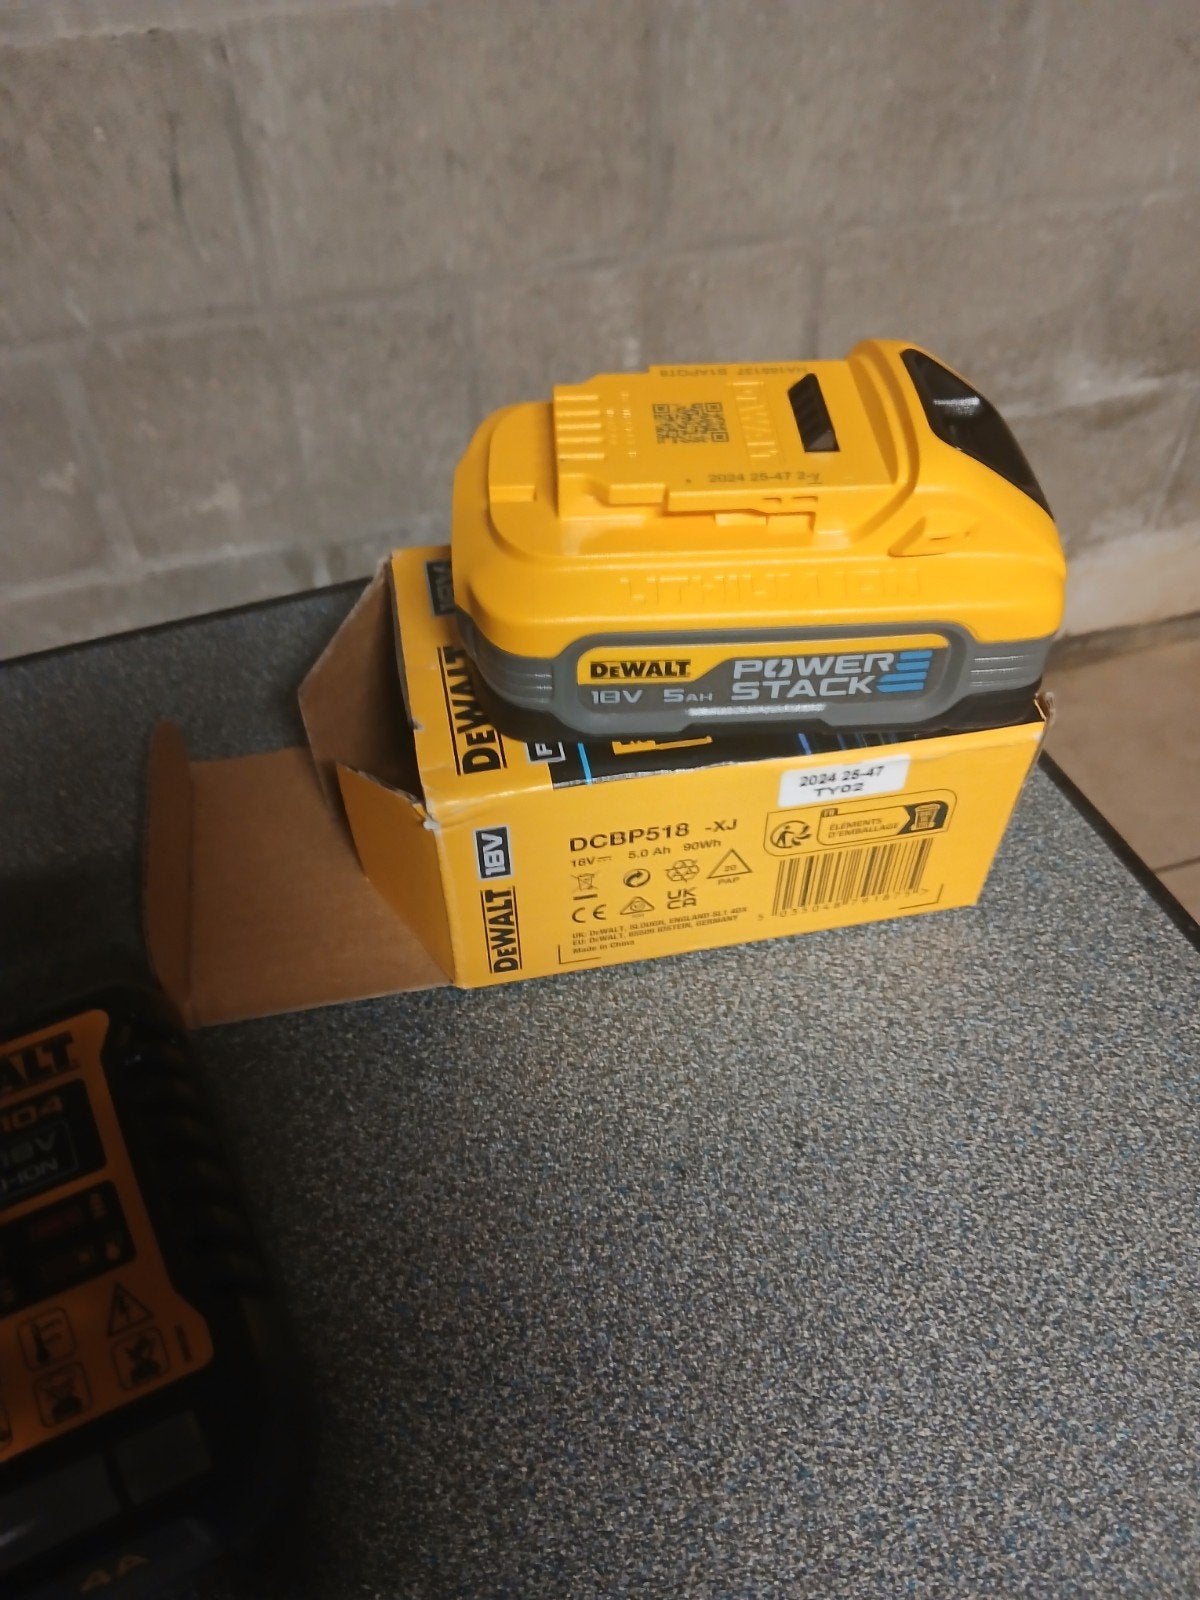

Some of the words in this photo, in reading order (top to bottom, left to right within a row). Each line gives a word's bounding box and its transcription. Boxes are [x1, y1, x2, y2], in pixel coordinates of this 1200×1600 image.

[708, 472, 745, 483] 2024
[733, 652, 894, 680] POWER
[591, 689, 643, 704] 18V
[731, 675, 876, 702] STACK
[799, 772, 837, 787] 2024
[841, 765, 885, 781] 25-47
[569, 822, 690, 852] DCBP518
[704, 818, 738, 833] -XJ
[481, 833, 506, 876] 18V
[628, 848, 649, 859] 5.0
[652, 846, 671, 856] Ah
[683, 839, 722, 852] 90Wh
[666, 886, 698, 900] UK
[666, 897, 698, 911] CA
